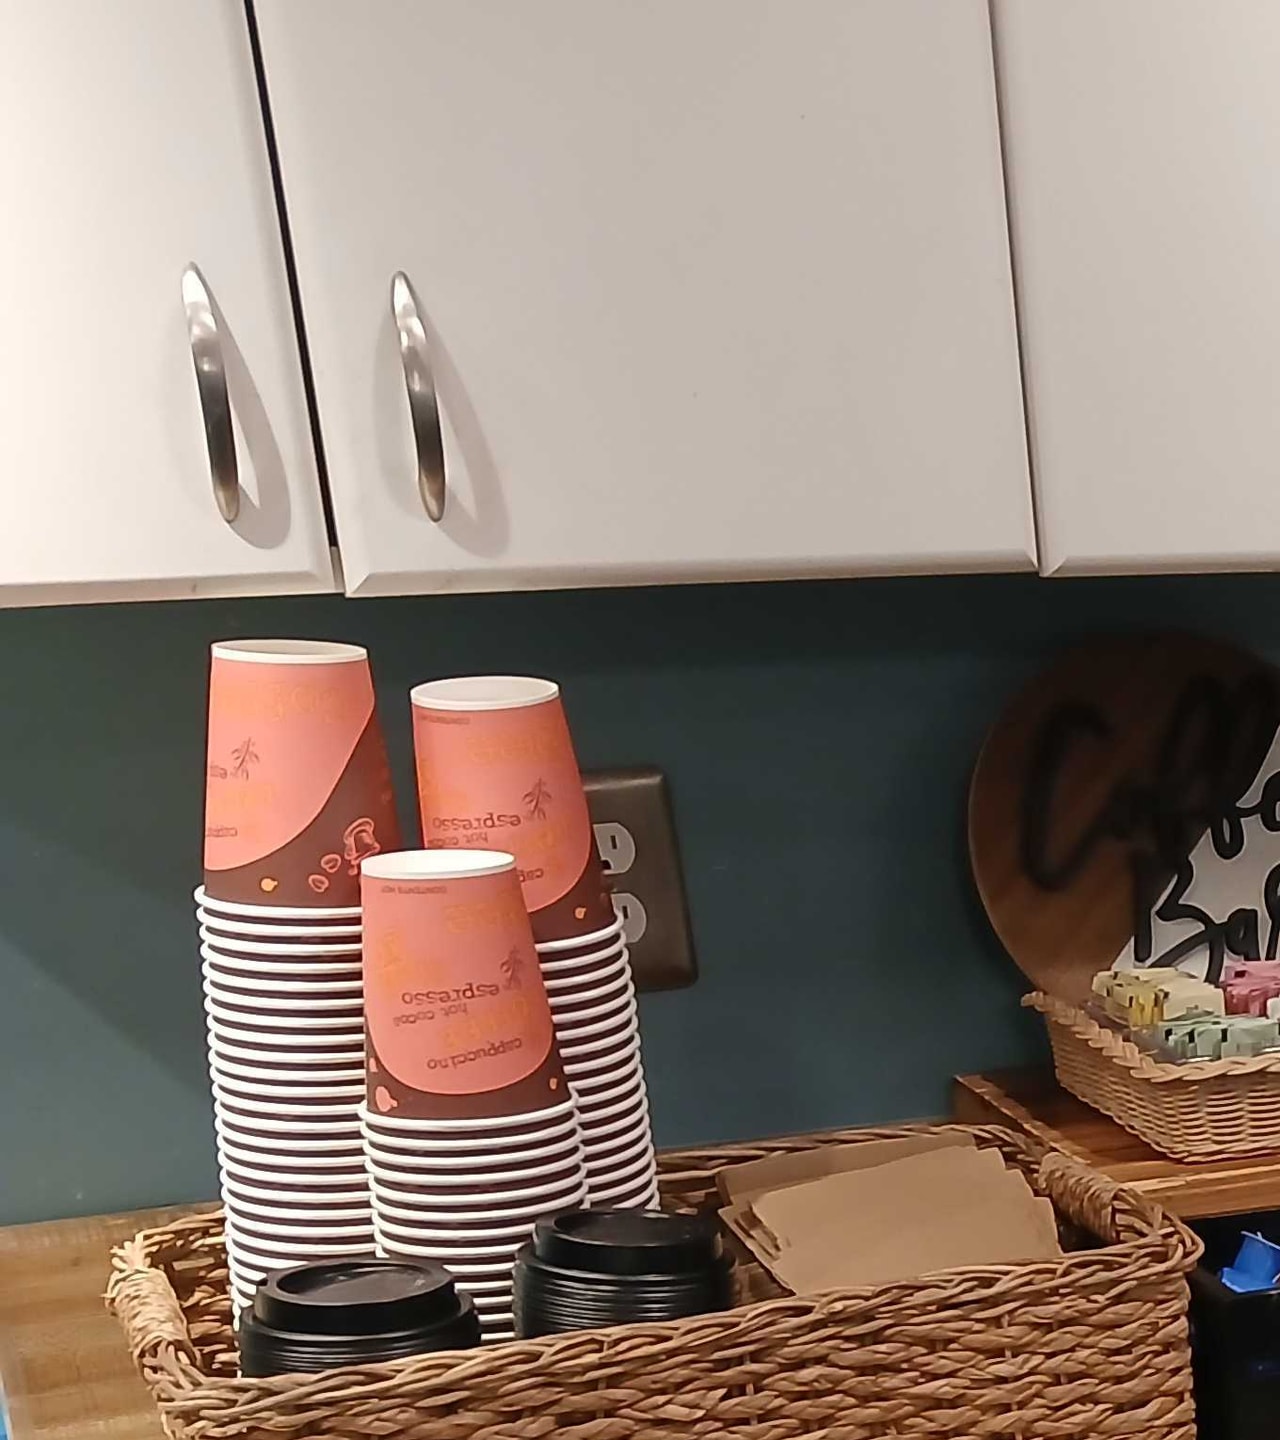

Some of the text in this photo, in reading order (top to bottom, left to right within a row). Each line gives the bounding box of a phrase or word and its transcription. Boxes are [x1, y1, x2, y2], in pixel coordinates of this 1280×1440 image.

[431, 813, 522, 832] espresso
[400, 983, 500, 1006] espresso
[426, 1037, 523, 1071] cappuccino
